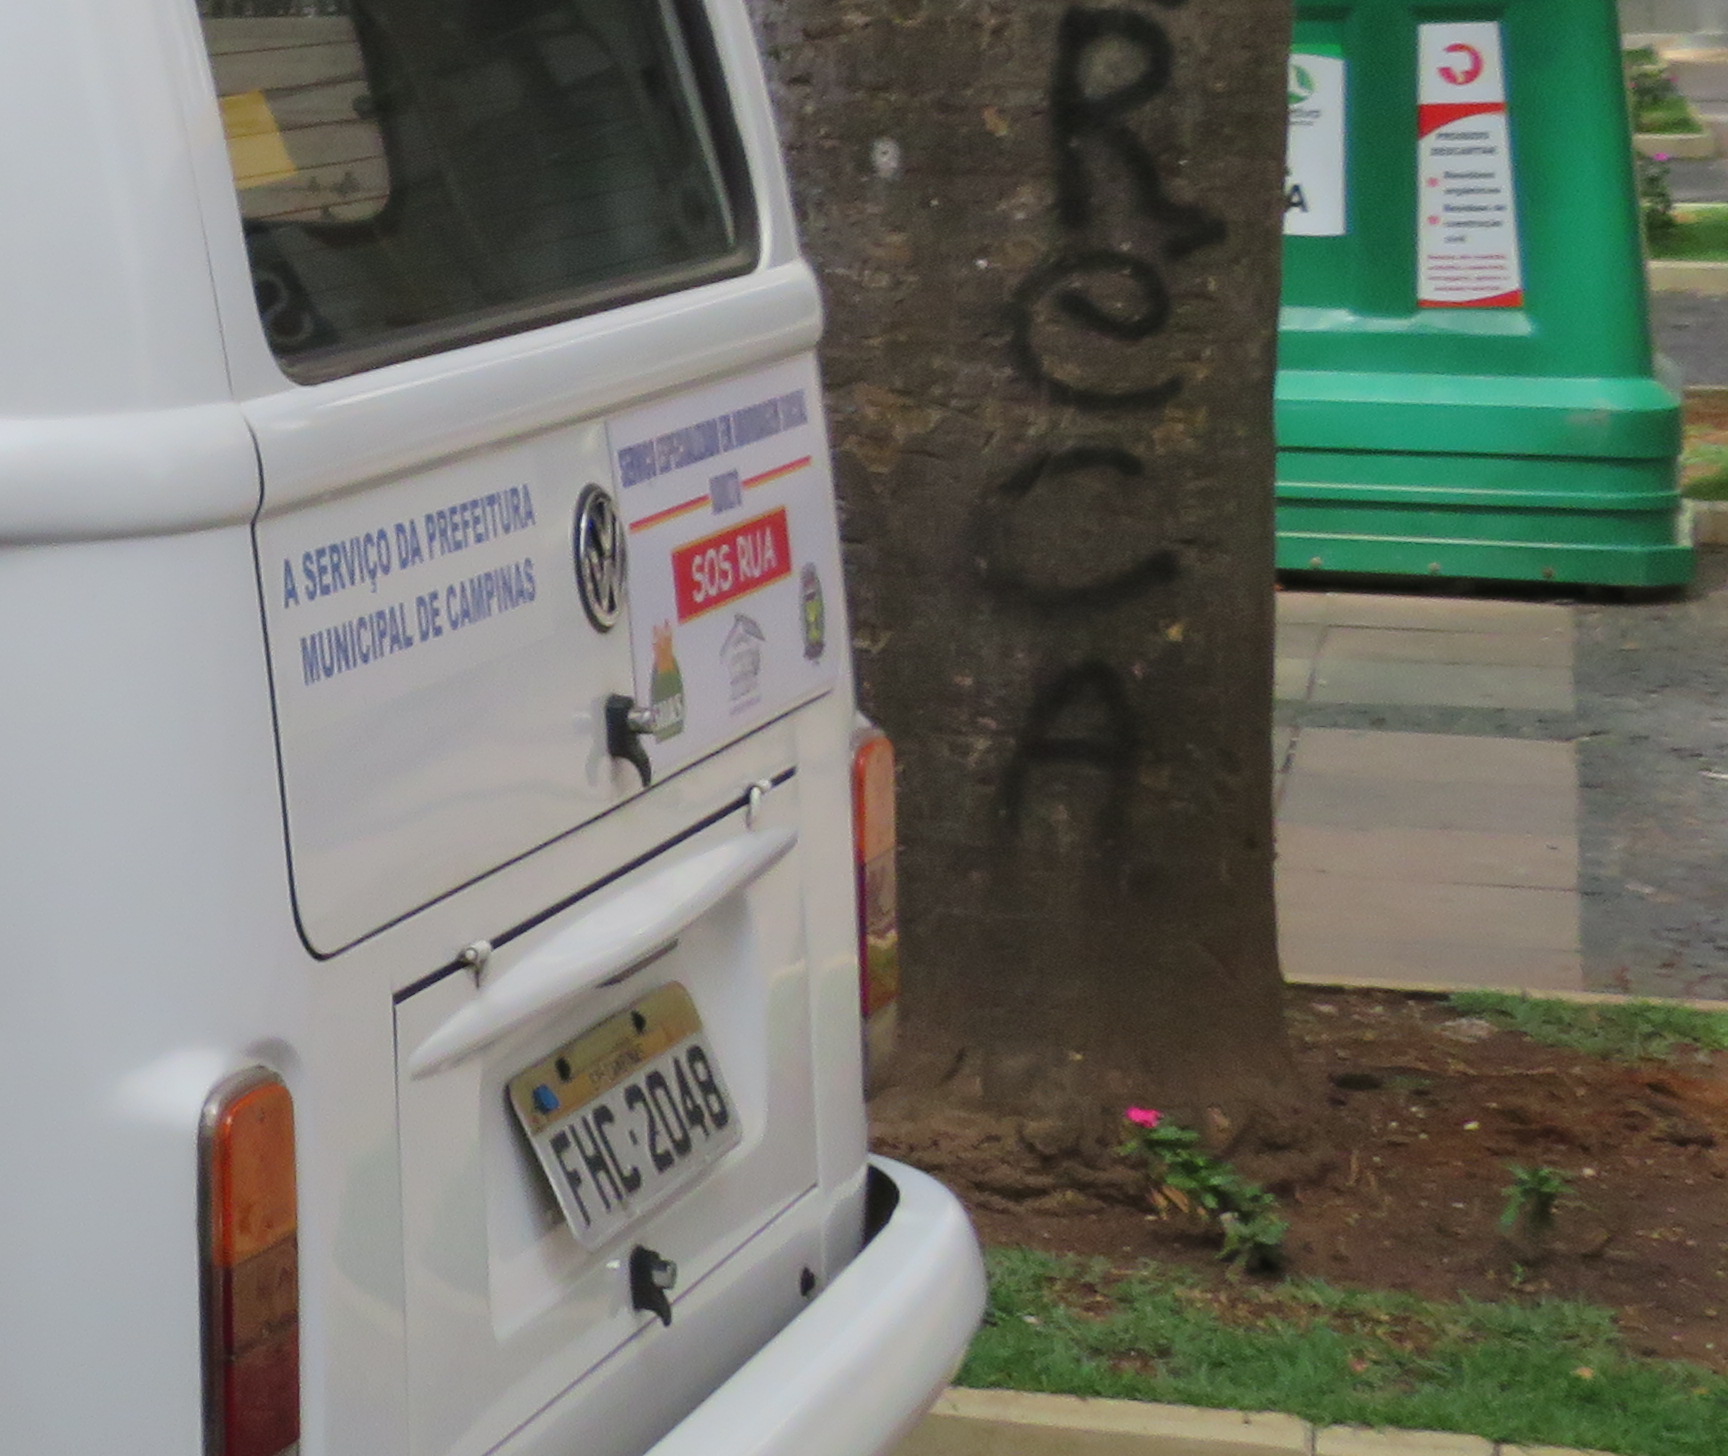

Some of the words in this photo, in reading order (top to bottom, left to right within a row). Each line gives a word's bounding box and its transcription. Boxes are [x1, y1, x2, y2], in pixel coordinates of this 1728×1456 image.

[283, 558, 300, 609] A
[302, 528, 392, 602] SERVIÇO
[394, 518, 424, 570] DA
[424, 484, 536, 561] PREFEITURA
[692, 544, 745, 603] SOS
[736, 526, 778, 583] RUA
[300, 602, 414, 686] MUNICIPAL
[415, 589, 443, 642] DE
[445, 556, 536, 631] CAMPINAS
